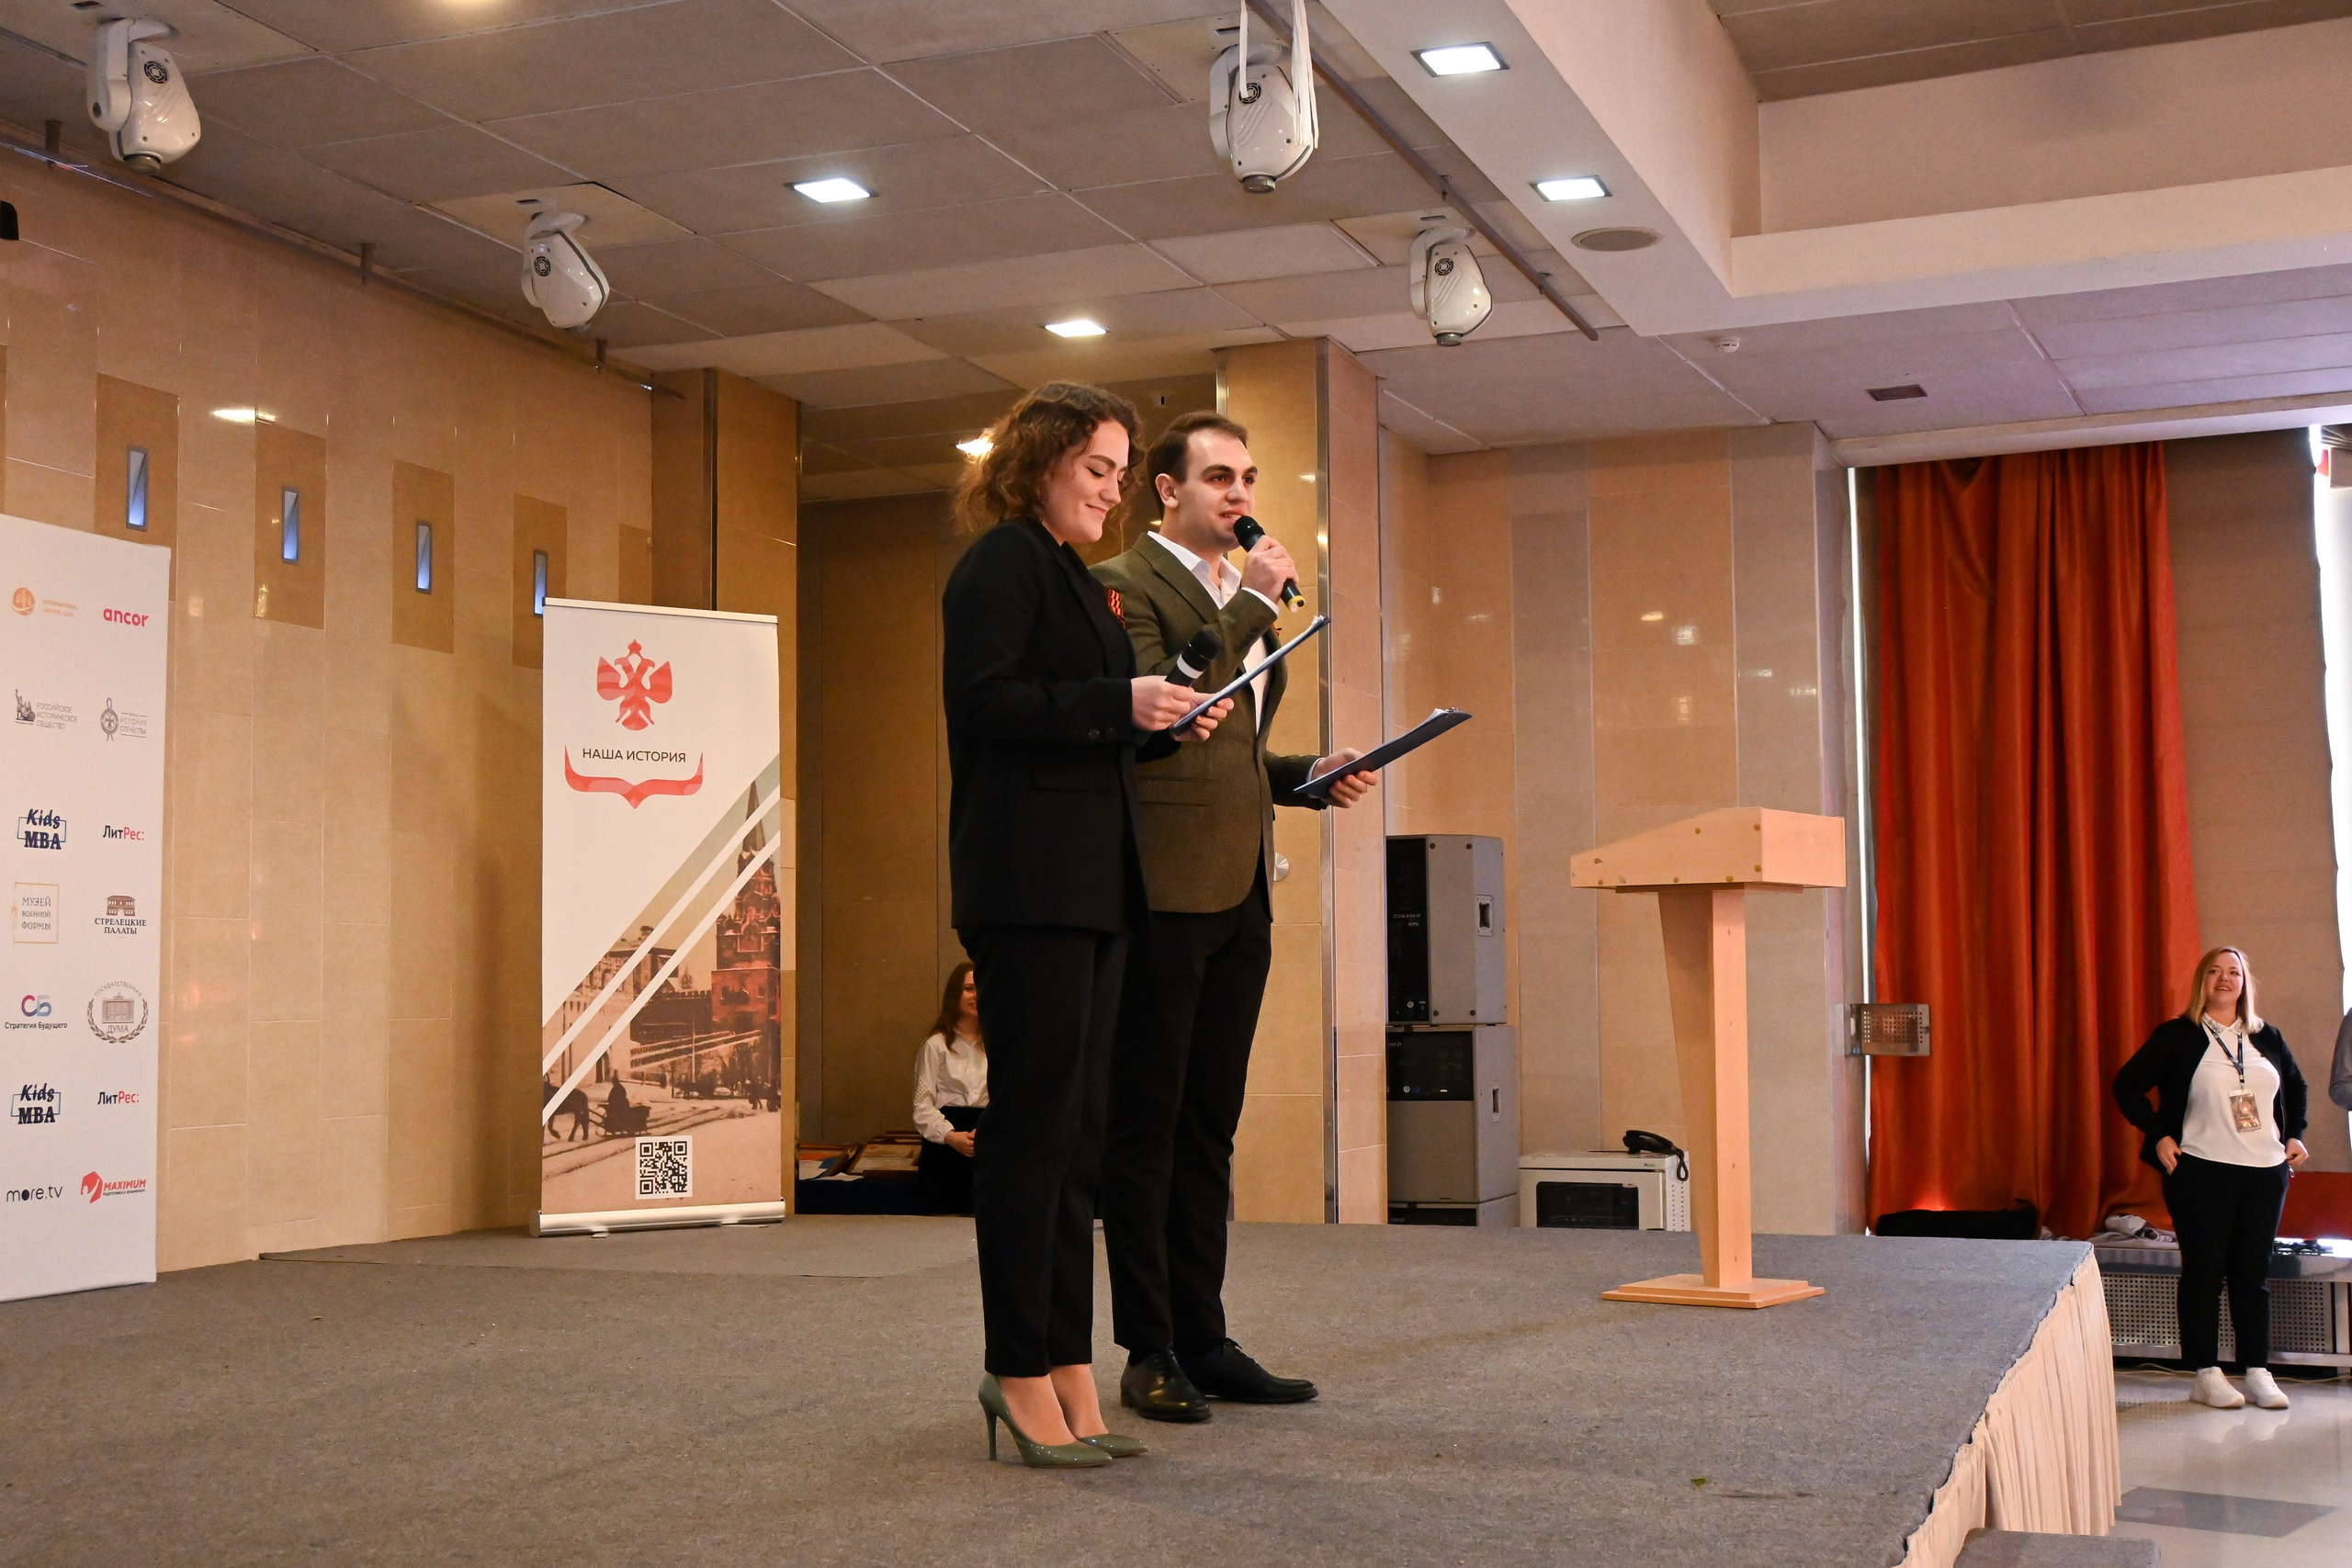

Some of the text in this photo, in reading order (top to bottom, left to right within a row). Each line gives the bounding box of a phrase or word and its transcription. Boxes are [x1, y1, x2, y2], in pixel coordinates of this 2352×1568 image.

[103, 608, 149, 627] ancor
[582, 748, 686, 763] НАША ИСТОРИЯ
[26, 808, 61, 829] Kids
[103, 825, 145, 840] ЛитРес:
[24, 830, 62, 850] MBA
[22, 897, 51, 907] МУЗЕЙ
[21, 909, 51, 919] ВОЕННОЙ
[21, 920, 51, 931] ФОРМЫ
[95, 918, 147, 927] СТРЕЛЕЦКИЕ
[104, 926, 138, 935] ПАЛАТЫ
[5, 1021, 68, 1031] Стратегия Будущего
[107, 1024, 130, 1034] ДУМА
[20, 1083, 54, 1102] Kids
[97, 1091, 140, 1105] ЛитРес:
[17, 1106, 56, 1124] MBA
[103, 1179, 146, 1191] MAXIMUM
[6, 1186, 63, 1202] more.tv
